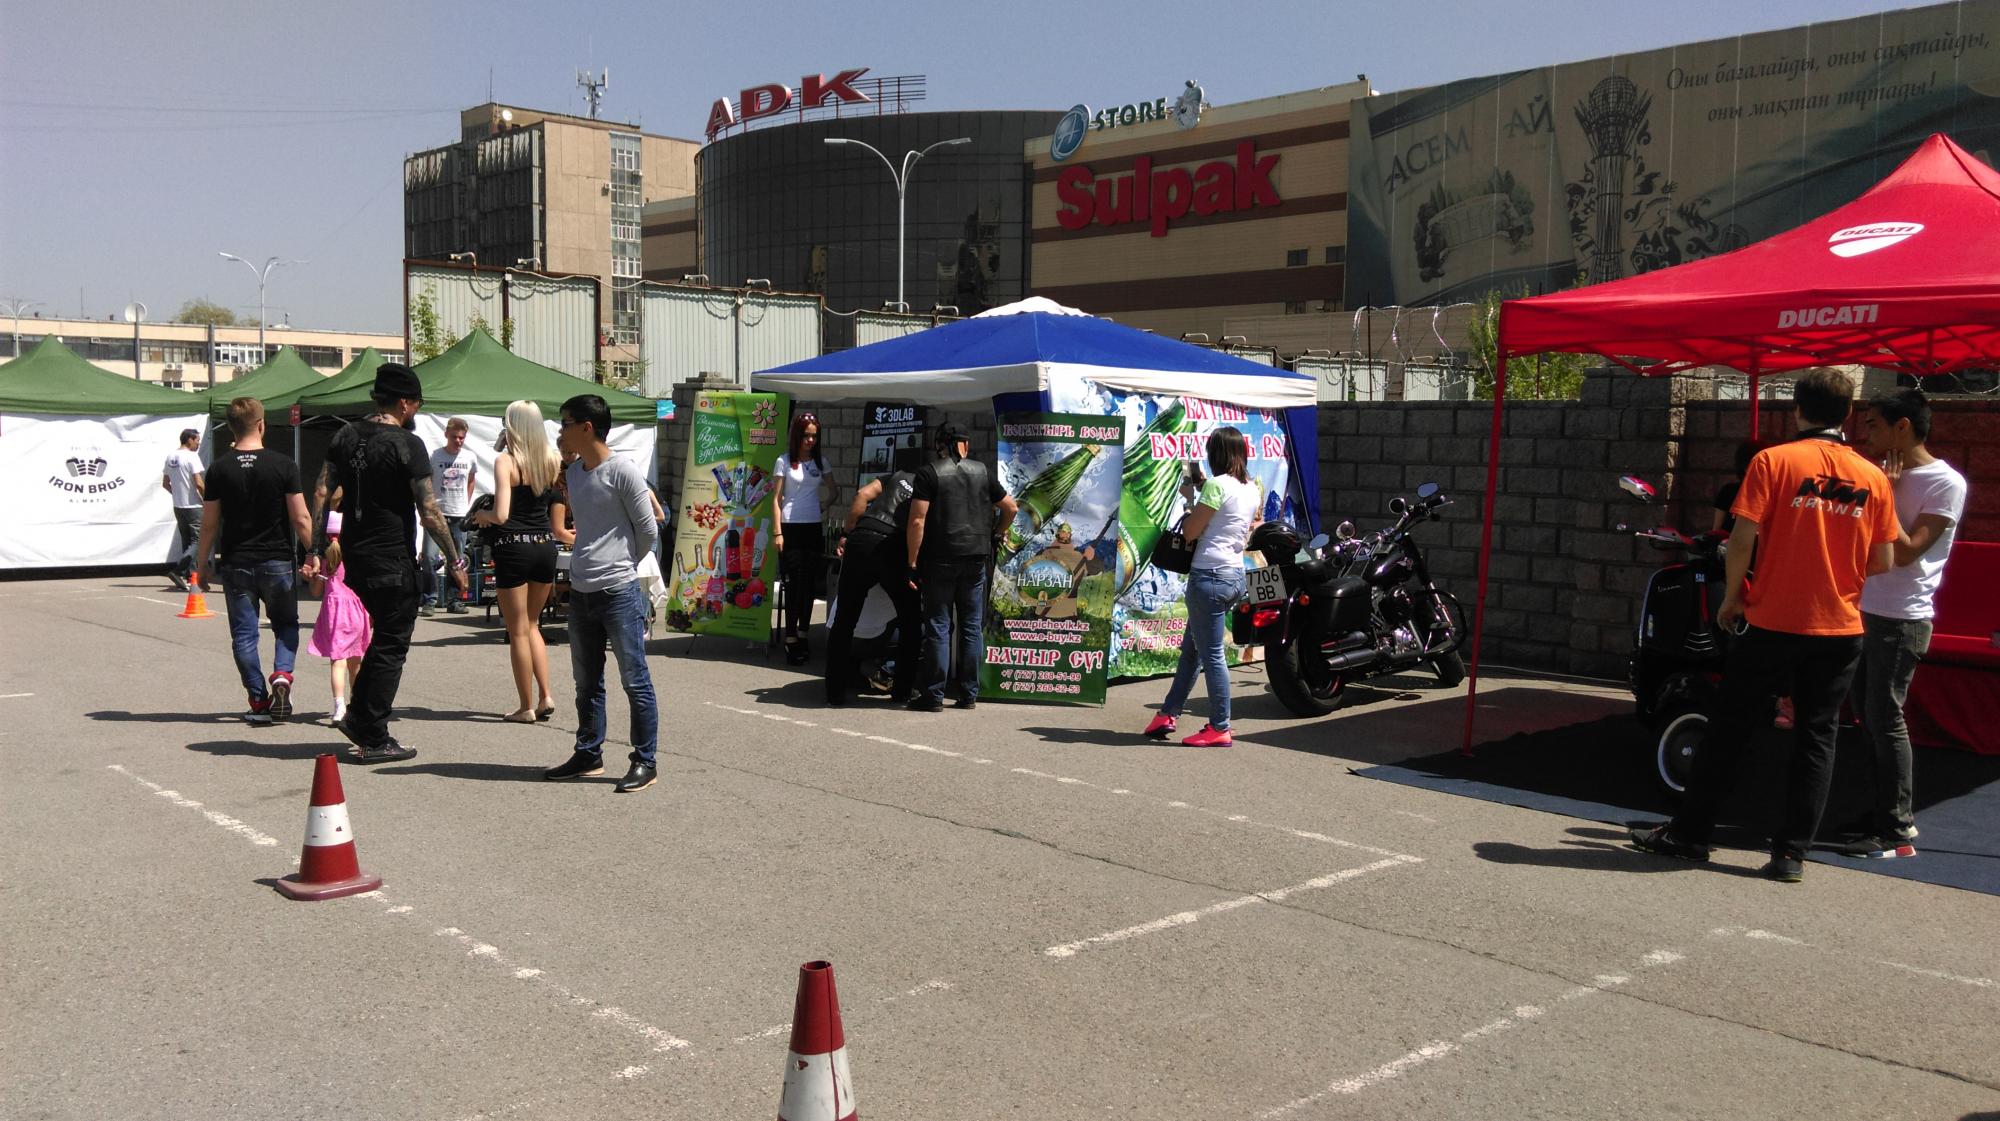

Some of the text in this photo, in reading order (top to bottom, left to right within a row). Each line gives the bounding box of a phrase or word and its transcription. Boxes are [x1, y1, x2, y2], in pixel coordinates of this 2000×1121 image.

[1827, 49, 1866, 68] оны
[705, 66, 872, 136] ADK
[1095, 97, 1168, 131] STORE
[1056, 140, 1282, 238] Sulpak
[1840, 226, 1916, 237] DUCATI
[1777, 303, 1880, 329] DUCATI
[888, 407, 914, 422] 3DLAB
[1003, 424, 1121, 441] БОГАТЫРЬ ВОДА!
[48, 476, 126, 494] IRON BROS
[1797, 473, 1871, 507] KTM
[1017, 574, 1073, 588] НАРЗАН
[1246, 567, 1279, 586] 7706
[1256, 585, 1276, 601] BB
[1004, 619, 1090, 631] www.pichevik.kz
[1010, 631, 1081, 644] www.e-buy.kz
[986, 646, 1104, 673] БАТЫР СУ!
[1001, 669, 1081, 681] +7 (727) 268-51-99
[1000, 681, 1012, 690] +7
[1013, 681, 1035, 692] (727)
